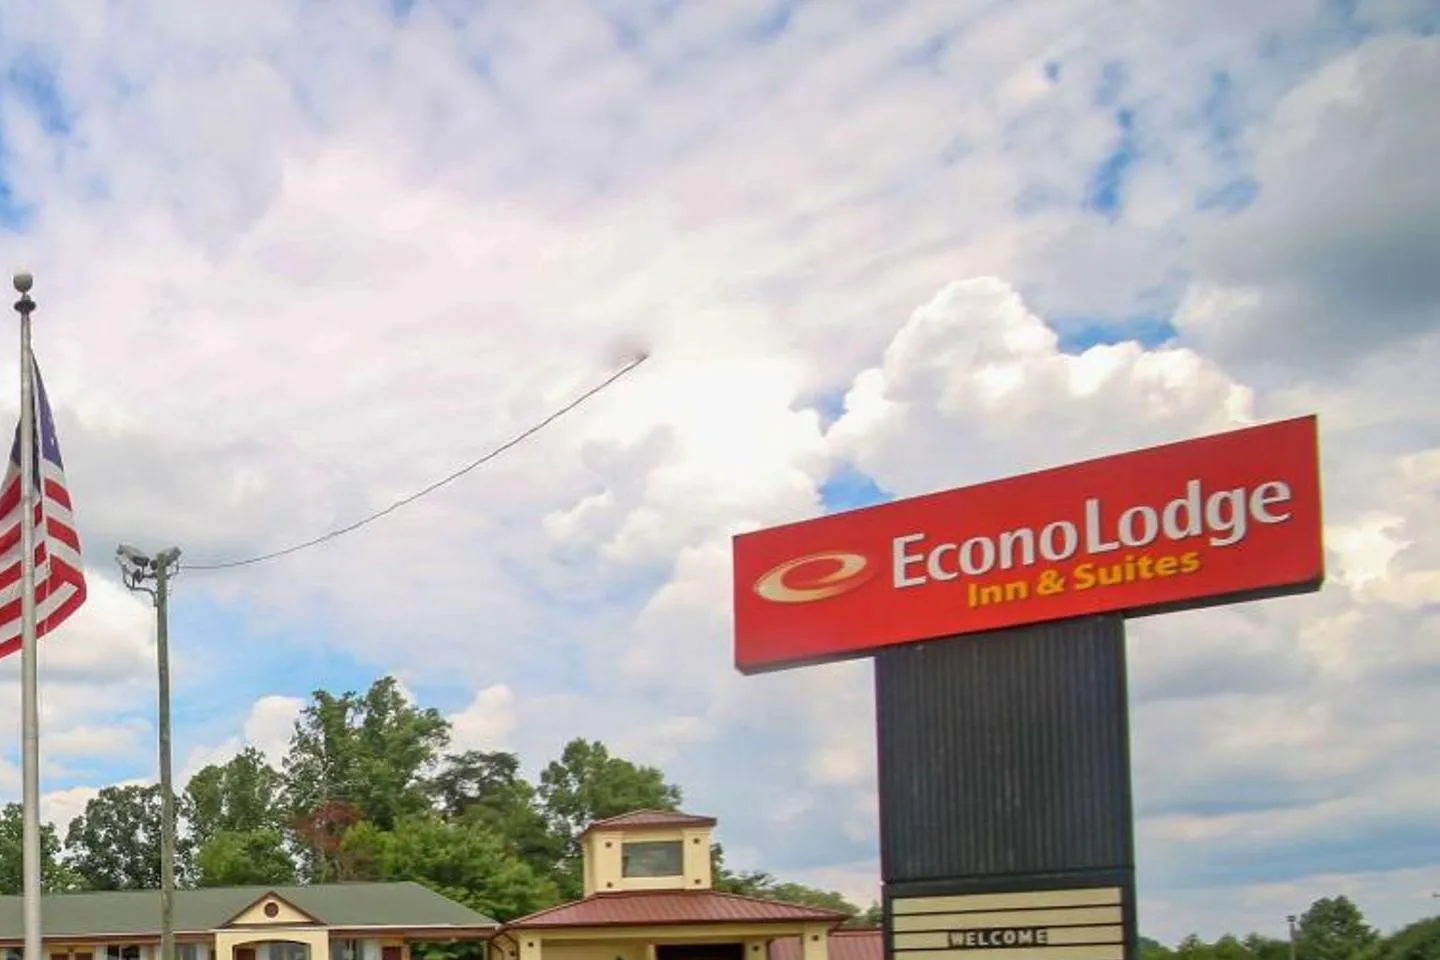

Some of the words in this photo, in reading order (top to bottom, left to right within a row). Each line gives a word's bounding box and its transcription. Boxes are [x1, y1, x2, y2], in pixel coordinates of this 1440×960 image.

[891, 479, 1291, 589] EconoLodge
[969, 580, 1028, 607] Inn
[1037, 570, 1065, 596] &
[1074, 550, 1201, 590] Suites
[952, 929, 1048, 947] WELCOME
